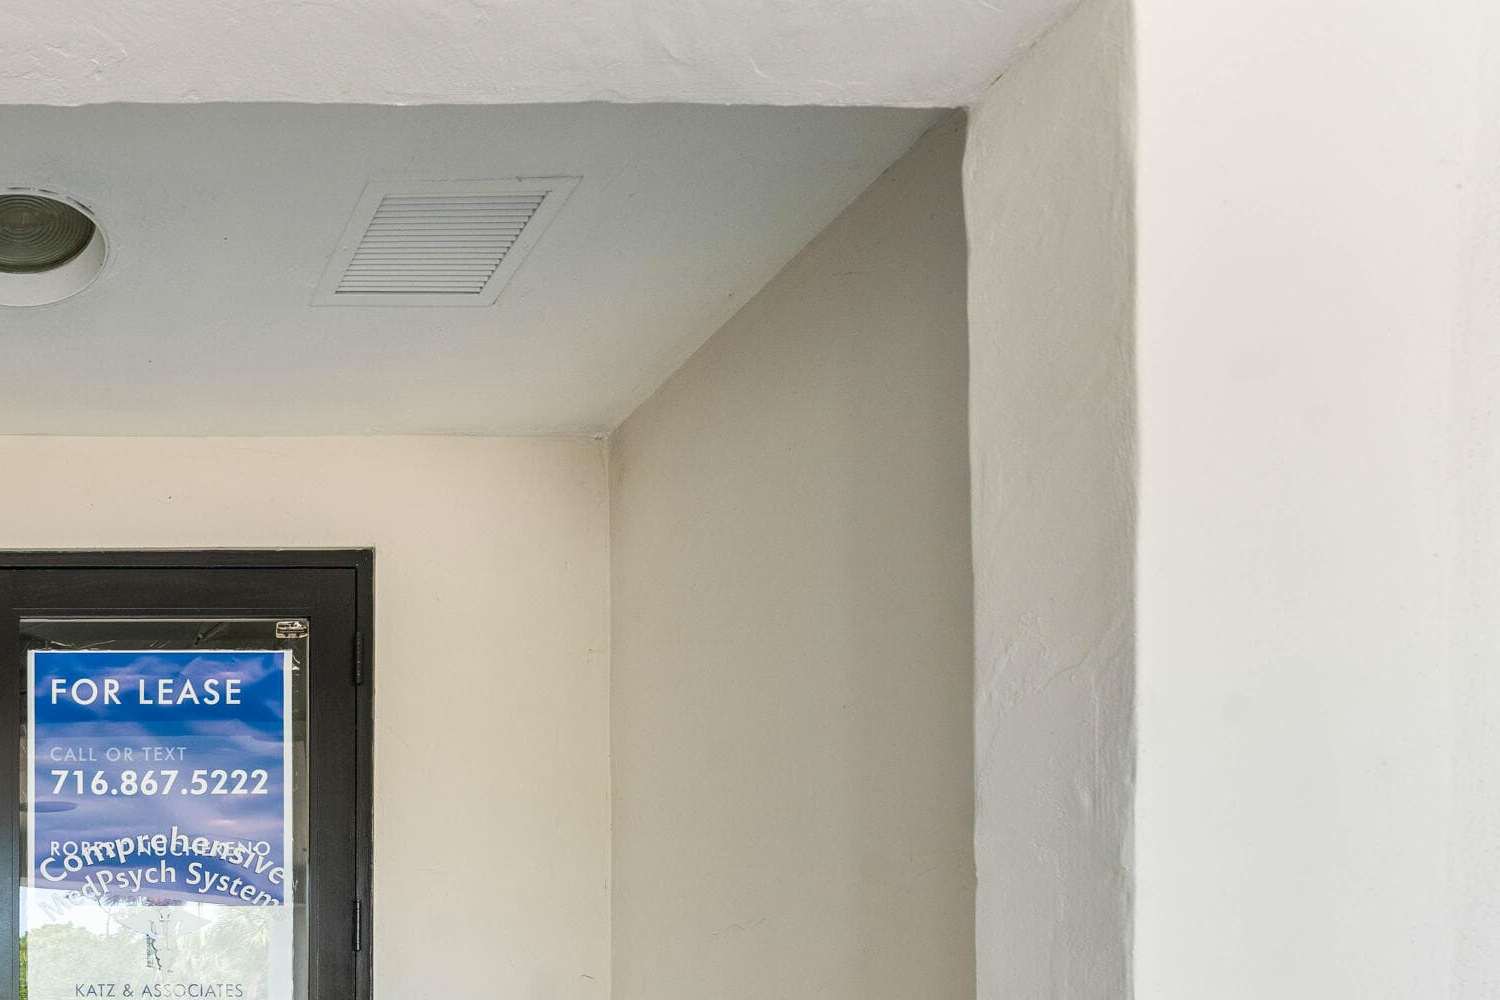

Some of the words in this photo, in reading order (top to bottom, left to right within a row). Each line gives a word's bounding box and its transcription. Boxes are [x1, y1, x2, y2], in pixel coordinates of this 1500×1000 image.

[51, 678, 122, 705] FOR
[139, 678, 242, 705] LEASE
[50, 746, 97, 762] CALL
[106, 746, 133, 762] OR
[142, 746, 187, 762] TEXT
[51, 769, 268, 795] 716.867.5222
[40, 826, 287, 885] Comprehensive
[39, 860, 176, 922] MedPsych
[75, 983, 116, 997] KATZ
[122, 983, 134, 997] &
[141, 983, 244, 998] ASSOCIATES
